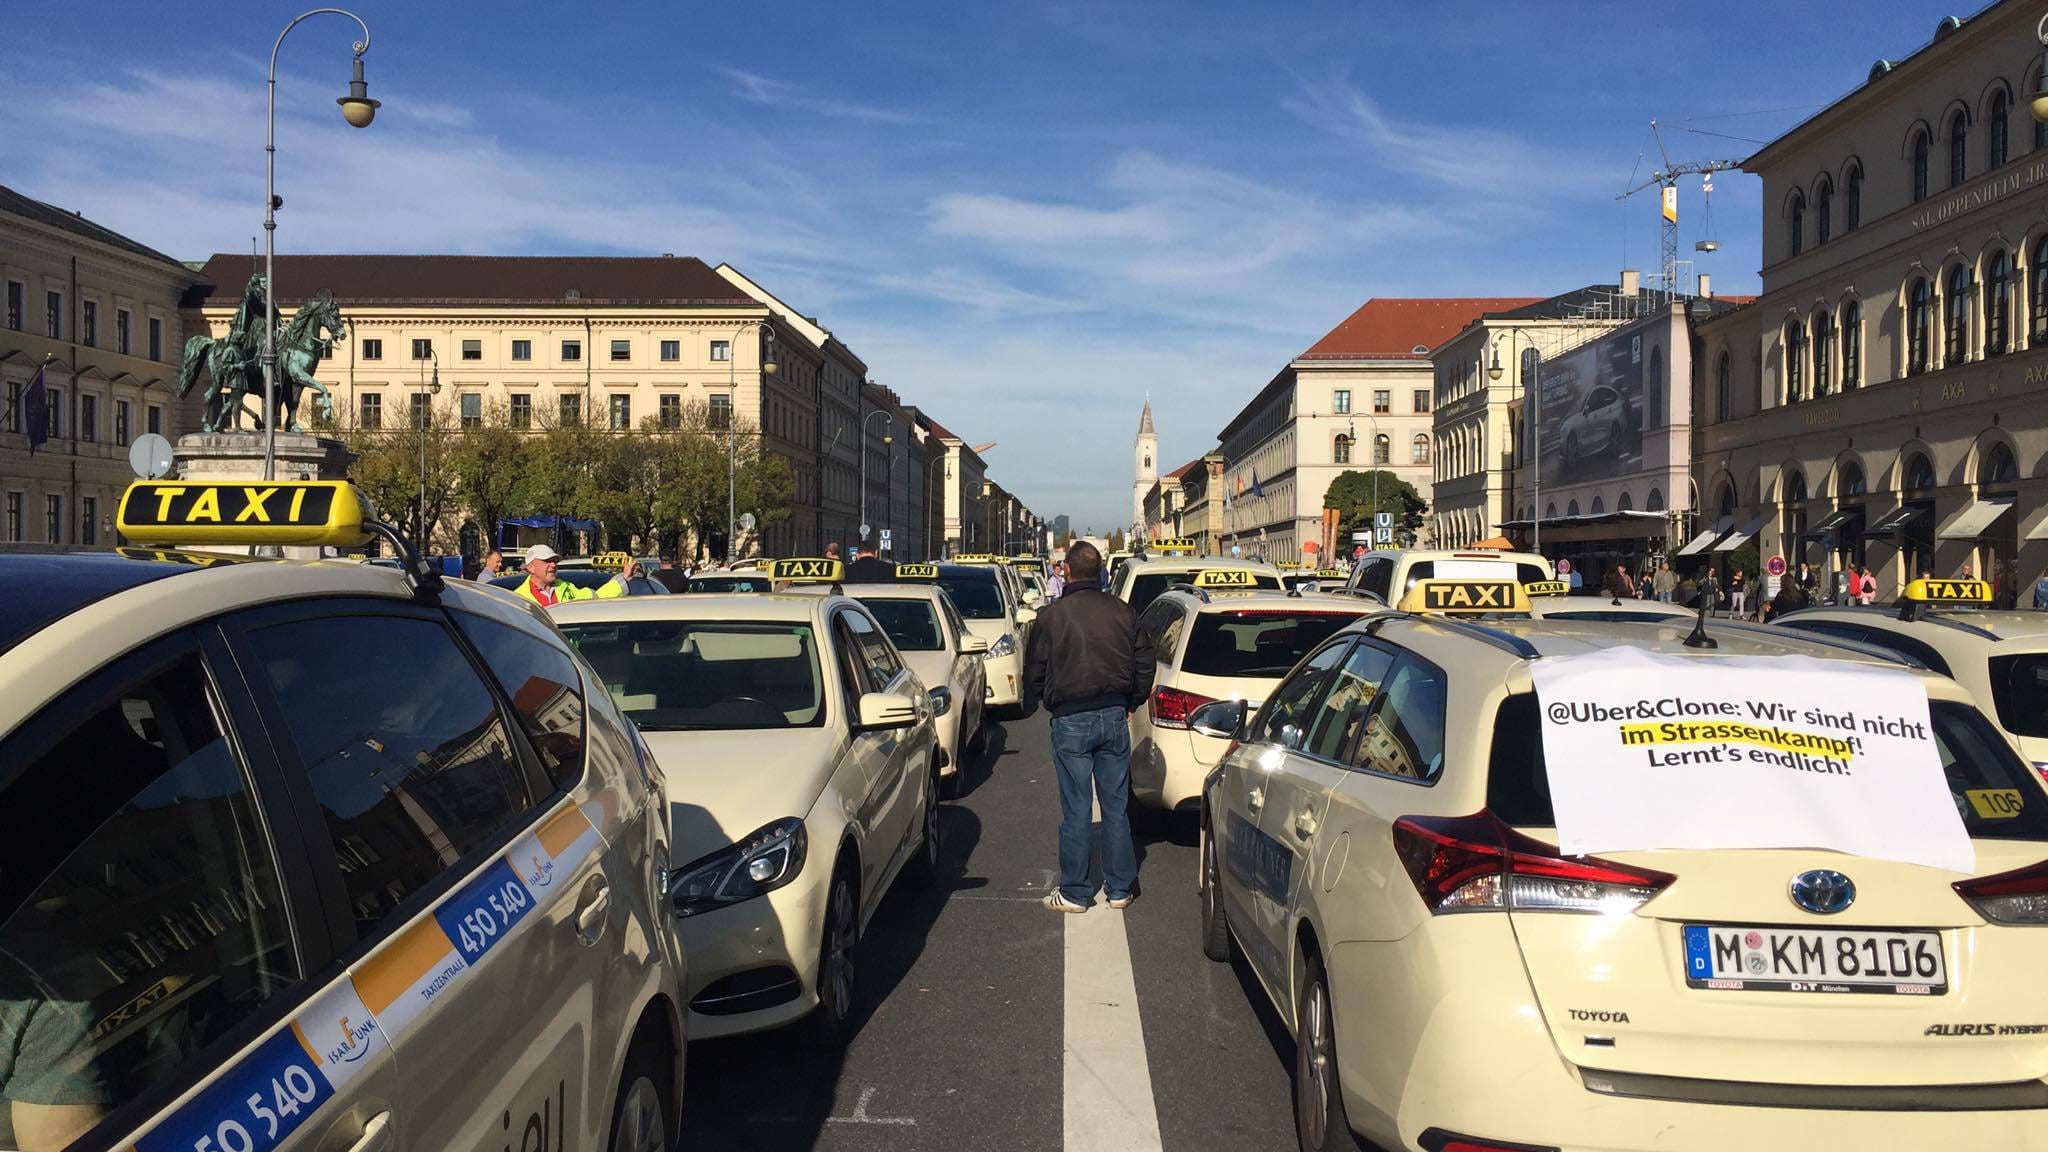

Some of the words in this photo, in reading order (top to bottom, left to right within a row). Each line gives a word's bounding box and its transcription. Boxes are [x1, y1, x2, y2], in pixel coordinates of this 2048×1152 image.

[1938, 173, 2020, 220] OPPENHEIM
[154, 487, 307, 522] TAXI
[780, 561, 829, 576] TAXI
[904, 566, 931, 575] TAXI
[1206, 572, 1245, 583] TAXI
[1429, 585, 1510, 607] TAXI
[1532, 582, 1560, 592] TAXI
[1928, 583, 1982, 599] TAXI
[1547, 697, 1742, 726] @Uber&Clone:
[1745, 700, 1798, 725] Wir
[1802, 707, 1857, 731] sind
[1862, 714, 1928, 741] nicht
[1620, 725, 1655, 746] im
[1660, 721, 1866, 757] Strassenkampf!
[1747, 745, 1853, 776] endlich!
[1981, 792, 2024, 814] 106
[457, 907, 497, 953] 450
[488, 880, 526, 926] 540
[1695, 957, 1706, 970] D
[1714, 933, 1743, 973] M
[1770, 934, 1827, 975] KM
[1836, 936, 1939, 978] 8106
[420, 958, 465, 1001] TAXIZENTRALE
[1708, 980, 1744, 990] TOYOTA
[1822, 984, 1851, 993] München
[1895, 985, 1931, 994] TOYOTA
[1568, 1008, 1631, 1024] TOYOTA
[1923, 1023, 1997, 1037] AURIS
[246, 1064, 317, 1141] 540
